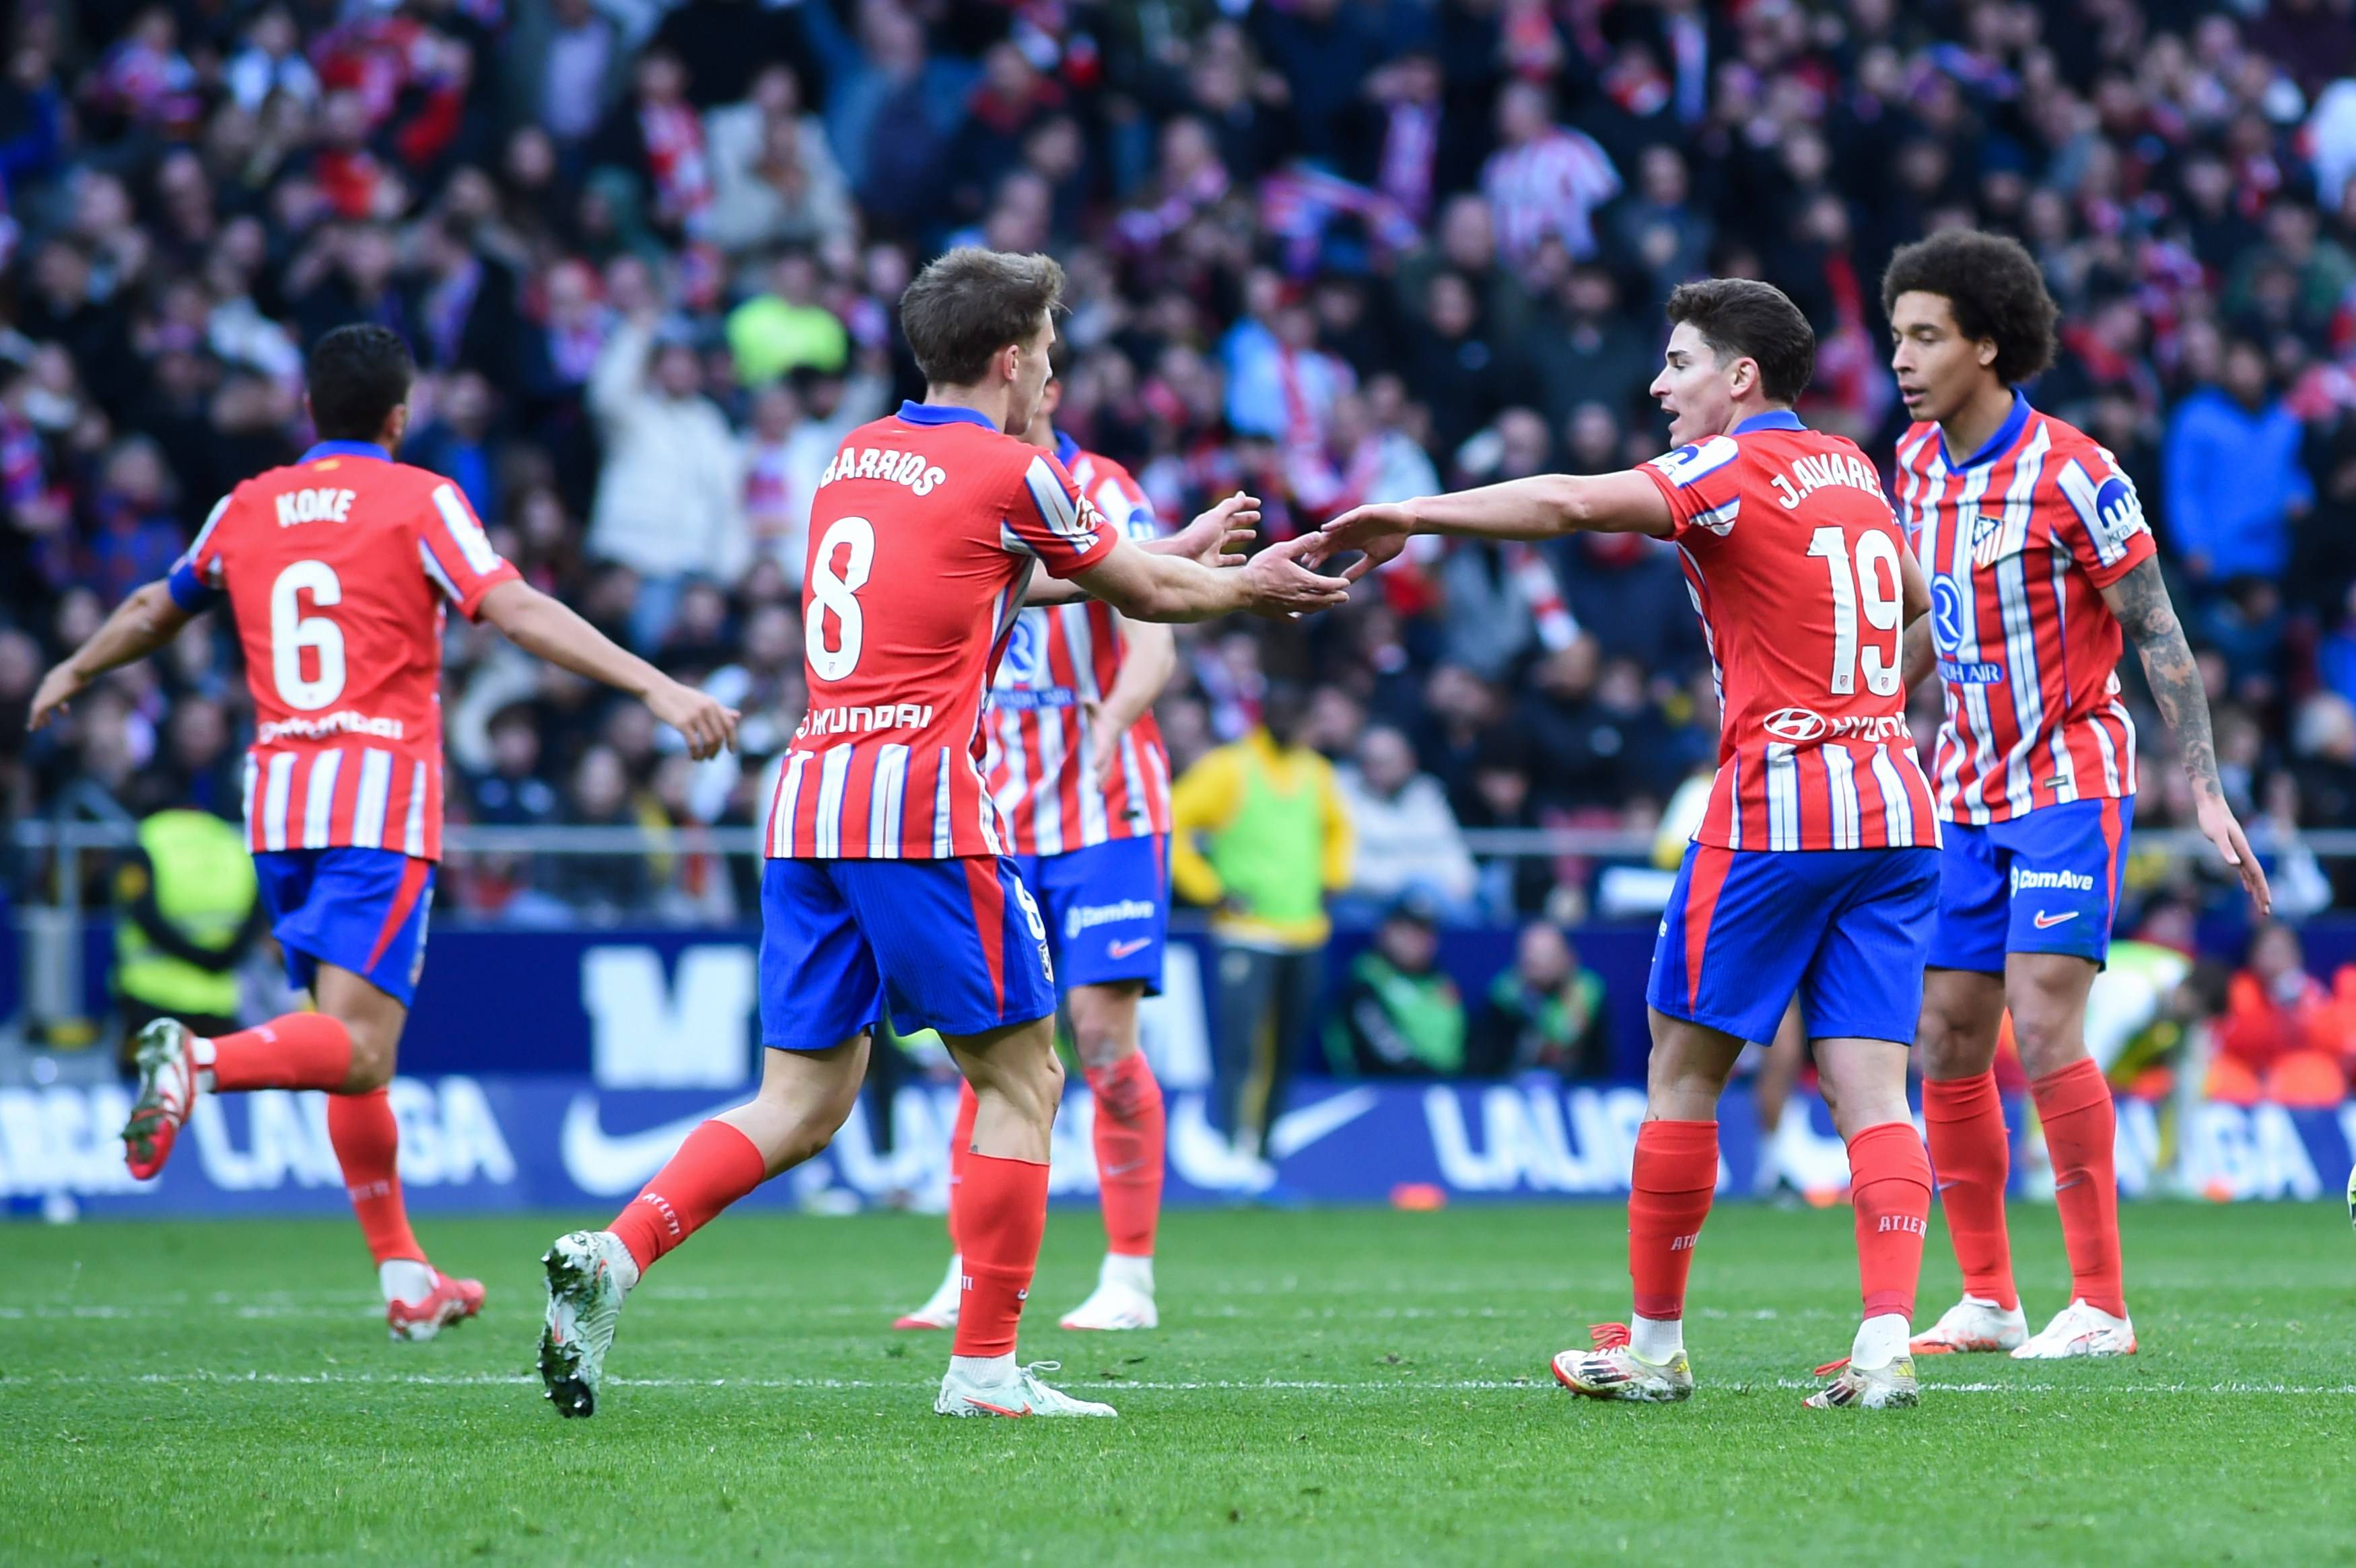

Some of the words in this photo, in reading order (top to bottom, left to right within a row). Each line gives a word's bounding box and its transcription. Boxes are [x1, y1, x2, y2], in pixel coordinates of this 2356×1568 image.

[1770, 452, 1889, 510] J.ALVARE
[275, 487, 357, 528] KOKE
[806, 515, 876, 682] 8
[1806, 525, 1904, 697] 19
[271, 559, 347, 711] 6
[1970, 663, 2001, 682] AIR
[1829, 711, 1912, 742] HYUN
[2019, 869, 2093, 891] ComAve
[189, 1075, 517, 1190] LALGA
[1422, 1083, 1732, 1195] LALI
[642, 1192, 681, 1236] ATLETI
[1670, 1232, 1700, 1251] ATL
